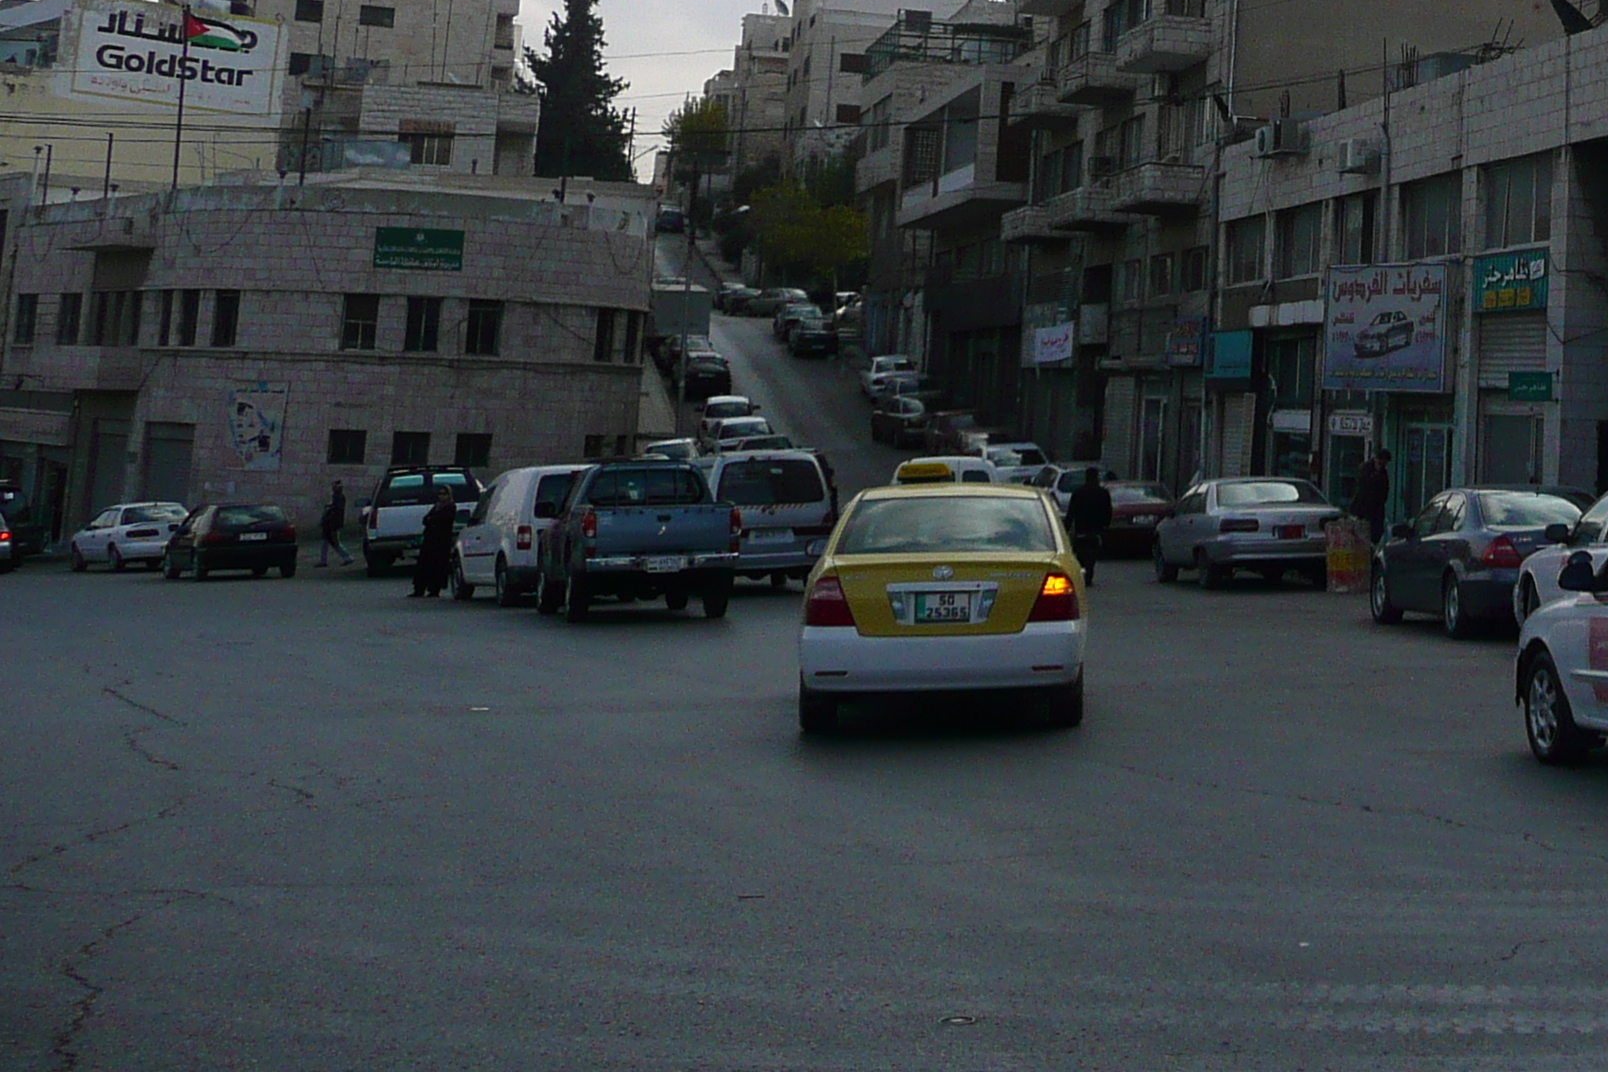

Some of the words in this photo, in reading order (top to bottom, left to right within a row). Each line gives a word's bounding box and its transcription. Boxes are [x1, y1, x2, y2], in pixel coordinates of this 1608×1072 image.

[96, 42, 254, 87] GoldStar
[1333, 269, 1388, 304] الفردوس
[1393, 268, 1441, 303] سفريات
